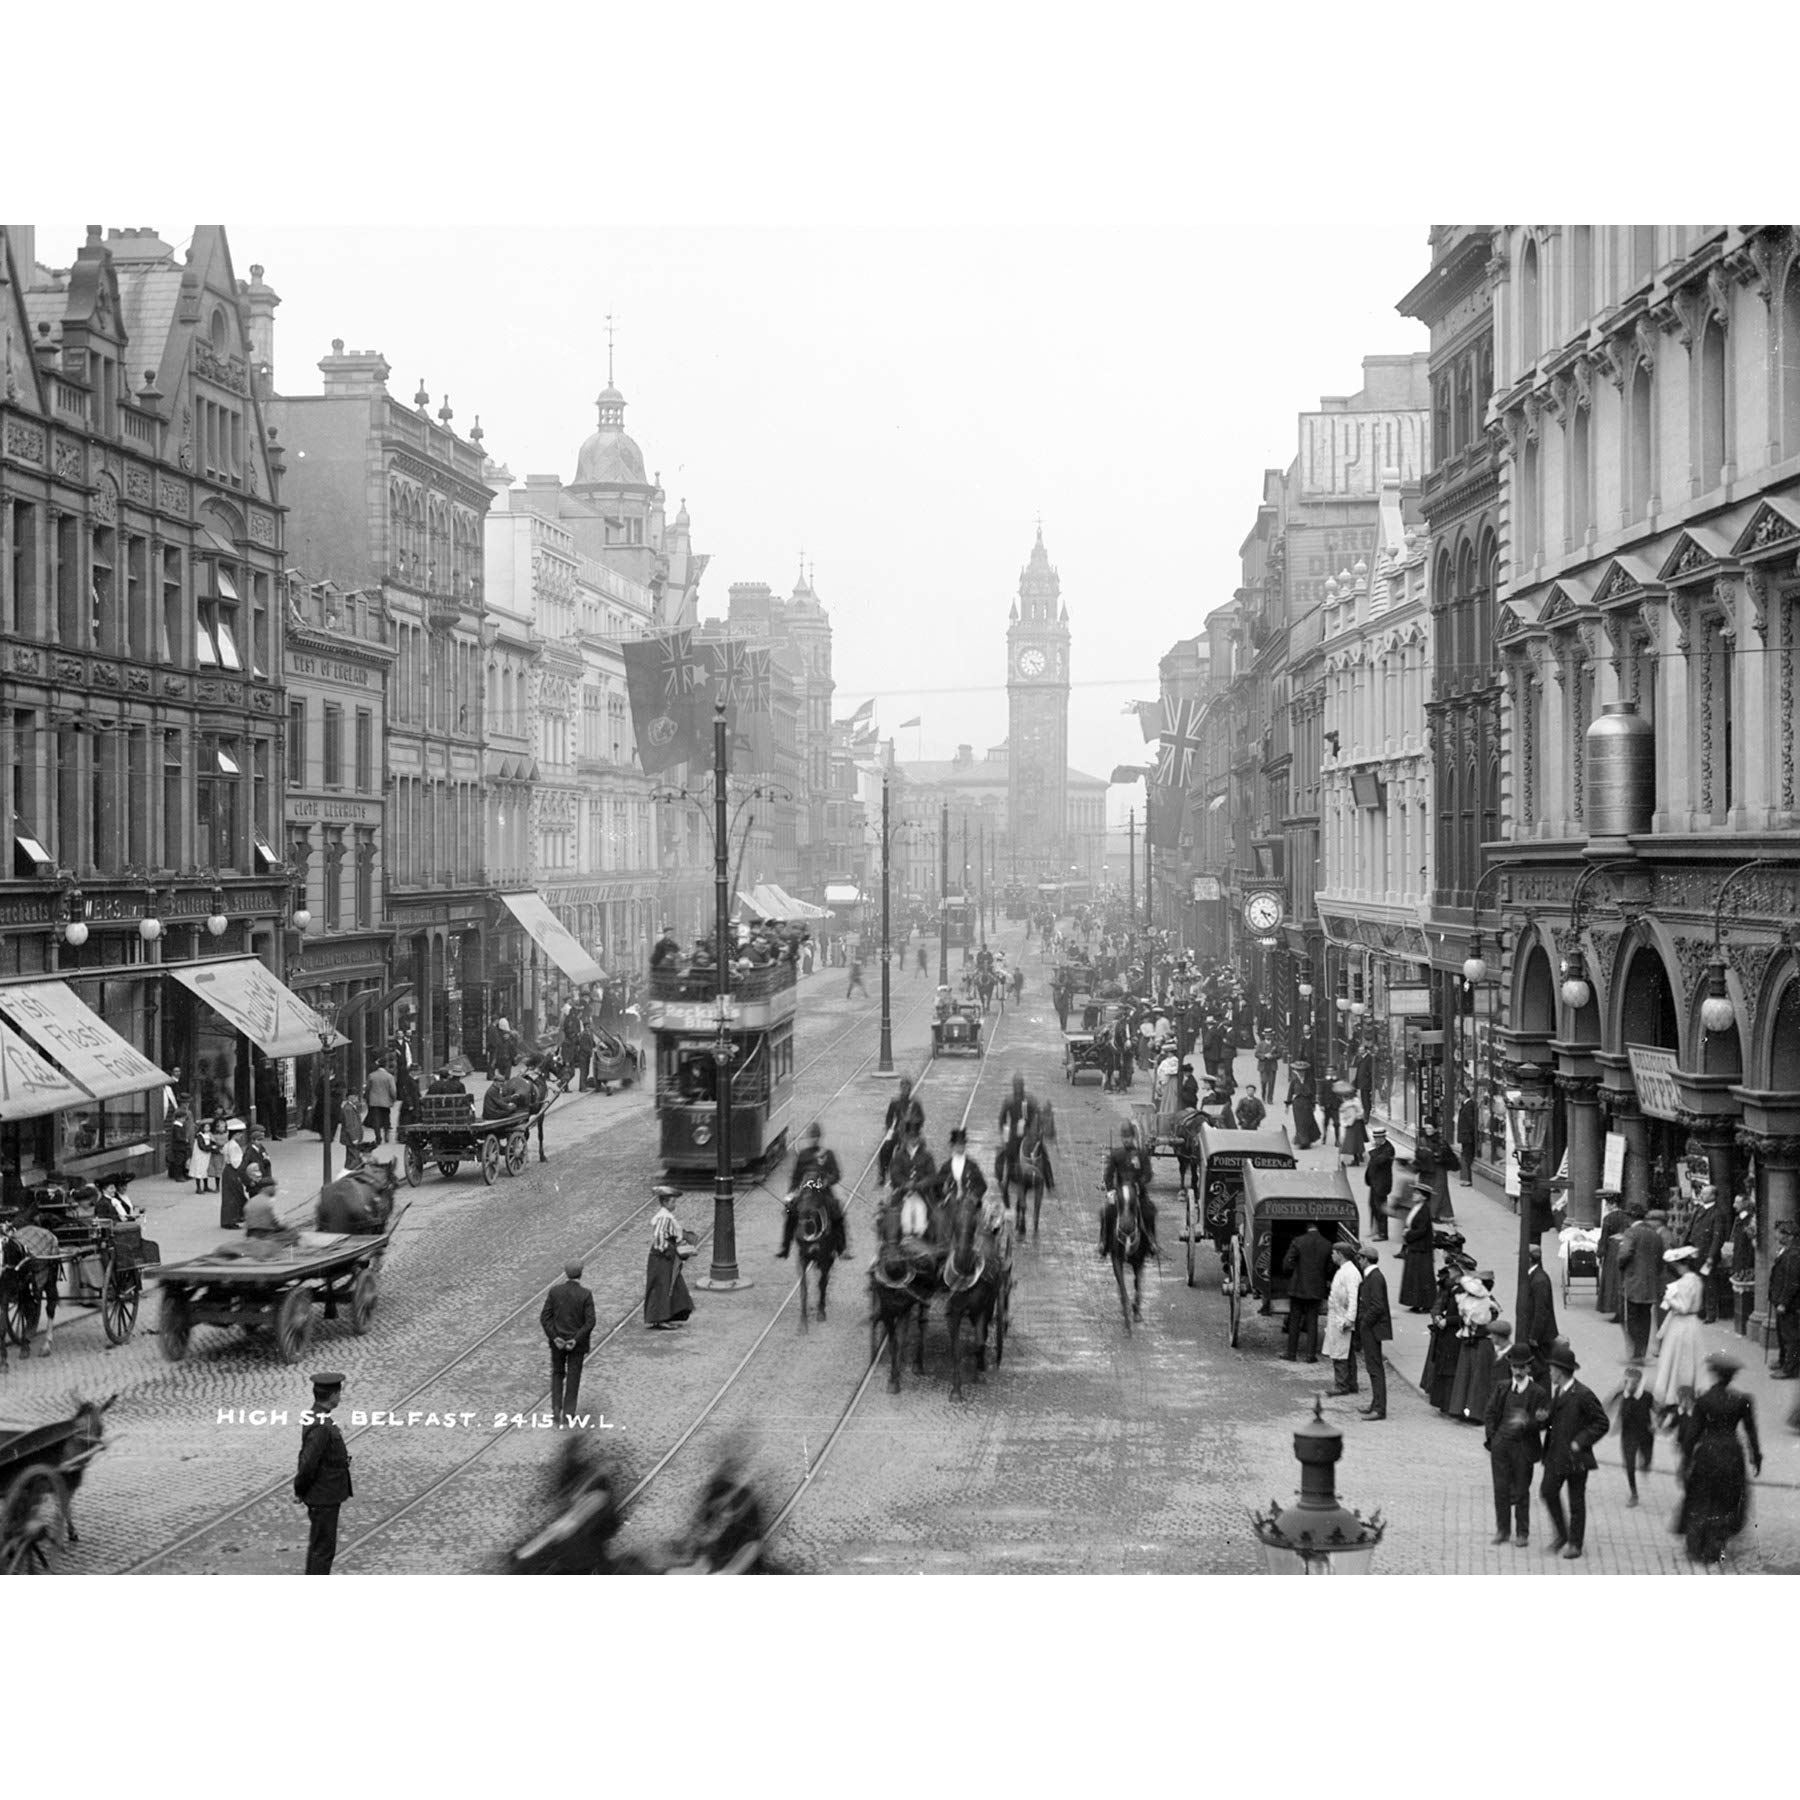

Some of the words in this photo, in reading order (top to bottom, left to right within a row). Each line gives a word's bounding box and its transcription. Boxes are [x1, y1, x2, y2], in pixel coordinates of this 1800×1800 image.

[293, 655, 316, 674] WEST
[321, 661, 333, 677] OF
[333, 662, 369, 685] ENGLAND
[294, 801, 318, 816] CLOTH
[324, 803, 367, 818] MERCHANTS
[59, 897, 122, 919] SWERS
[0, 991, 56, 1021] Fish
[43, 1020, 113, 1052] Flesh
[93, 1048, 153, 1080] Fowl
[1265, 1200, 1307, 1215] FORSTER
[1309, 1201, 1338, 1215] GREEN
